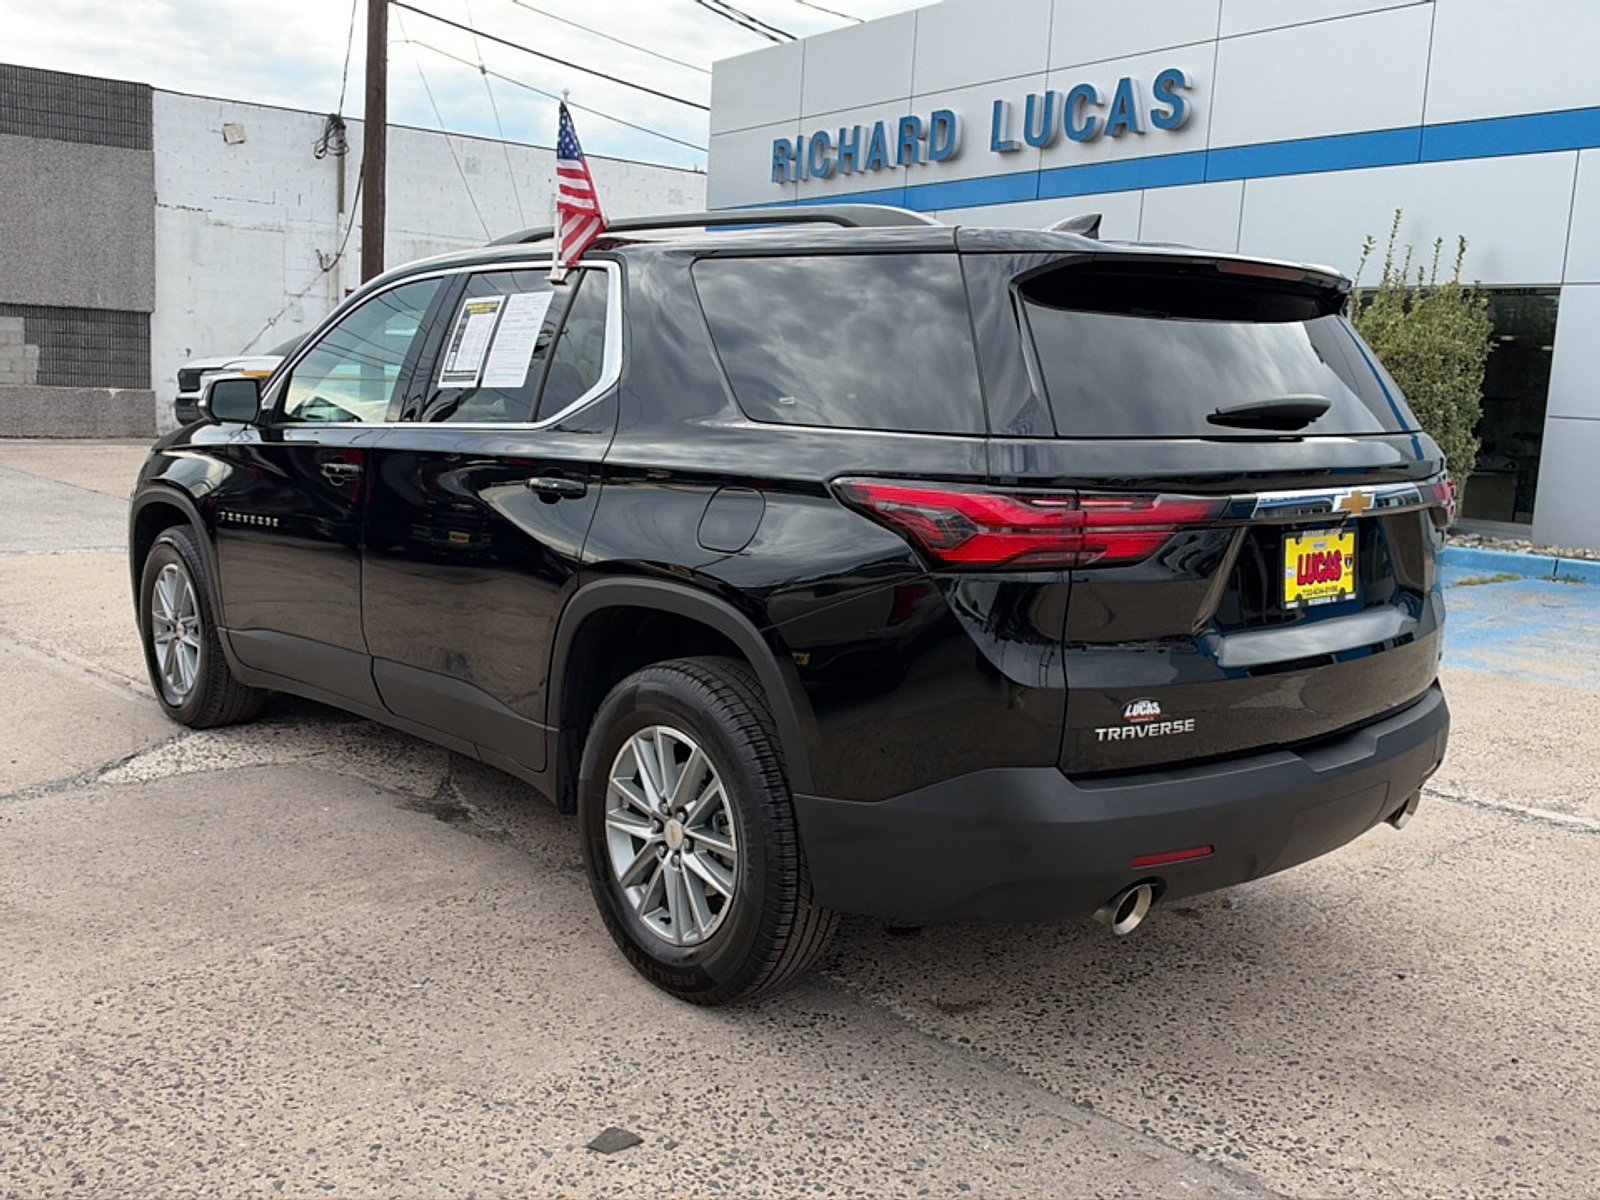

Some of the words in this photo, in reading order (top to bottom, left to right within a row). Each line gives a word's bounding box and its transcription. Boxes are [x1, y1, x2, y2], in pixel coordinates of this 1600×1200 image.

[771, 109, 961, 183] RICHARD
[990, 68, 1193, 152] LUCAS
[1297, 550, 1342, 586] LUCAS
[1124, 701, 1161, 717] LUCAS
[1094, 719, 1195, 741] TRAVERSE
